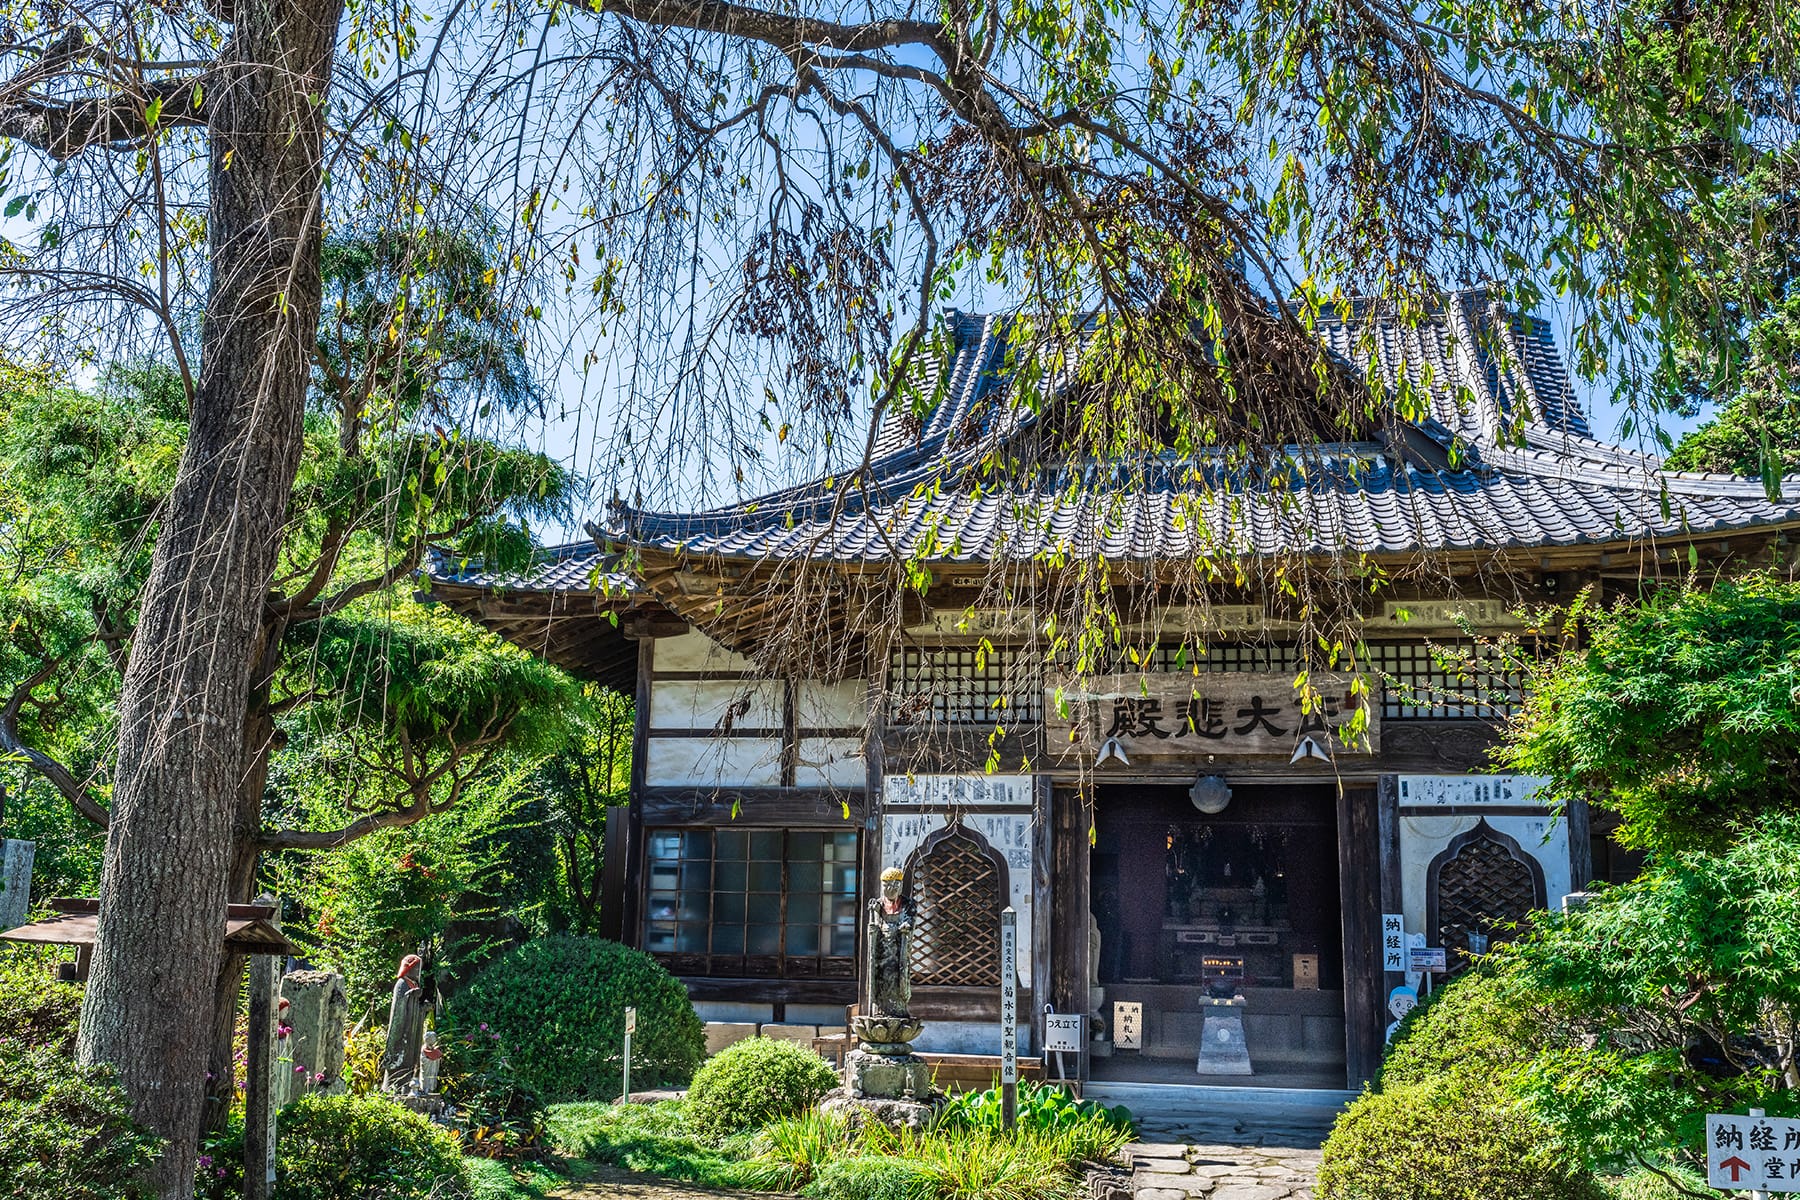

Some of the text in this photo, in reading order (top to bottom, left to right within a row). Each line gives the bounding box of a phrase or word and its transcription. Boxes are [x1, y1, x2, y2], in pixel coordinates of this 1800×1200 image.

[1386, 918, 1401, 967] 納経所
[1004, 986, 1014, 1076] 菊水寺聖観音像
[1047, 1020, 1078, 1029] つえ立て
[1124, 1015, 1133, 1043] 納札入
